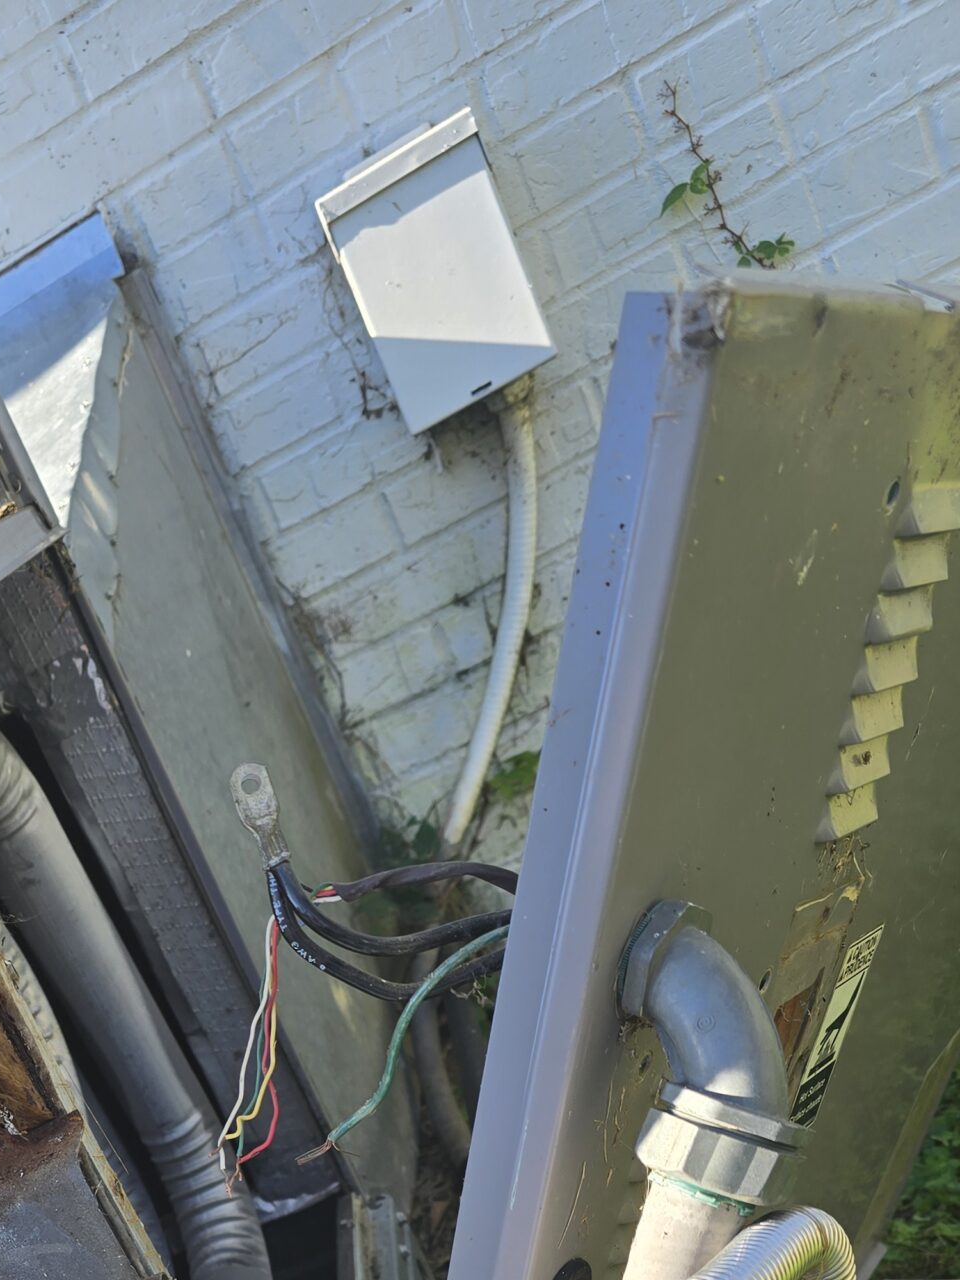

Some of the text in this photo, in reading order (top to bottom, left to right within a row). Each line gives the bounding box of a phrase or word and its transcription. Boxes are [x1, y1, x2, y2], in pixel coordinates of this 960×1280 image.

[272, 900, 288, 932] TYPE
[291, 941, 316, 964] AWG
[852, 934, 879, 960] CAUTION
[844, 949, 875, 976] PRUDENCE
